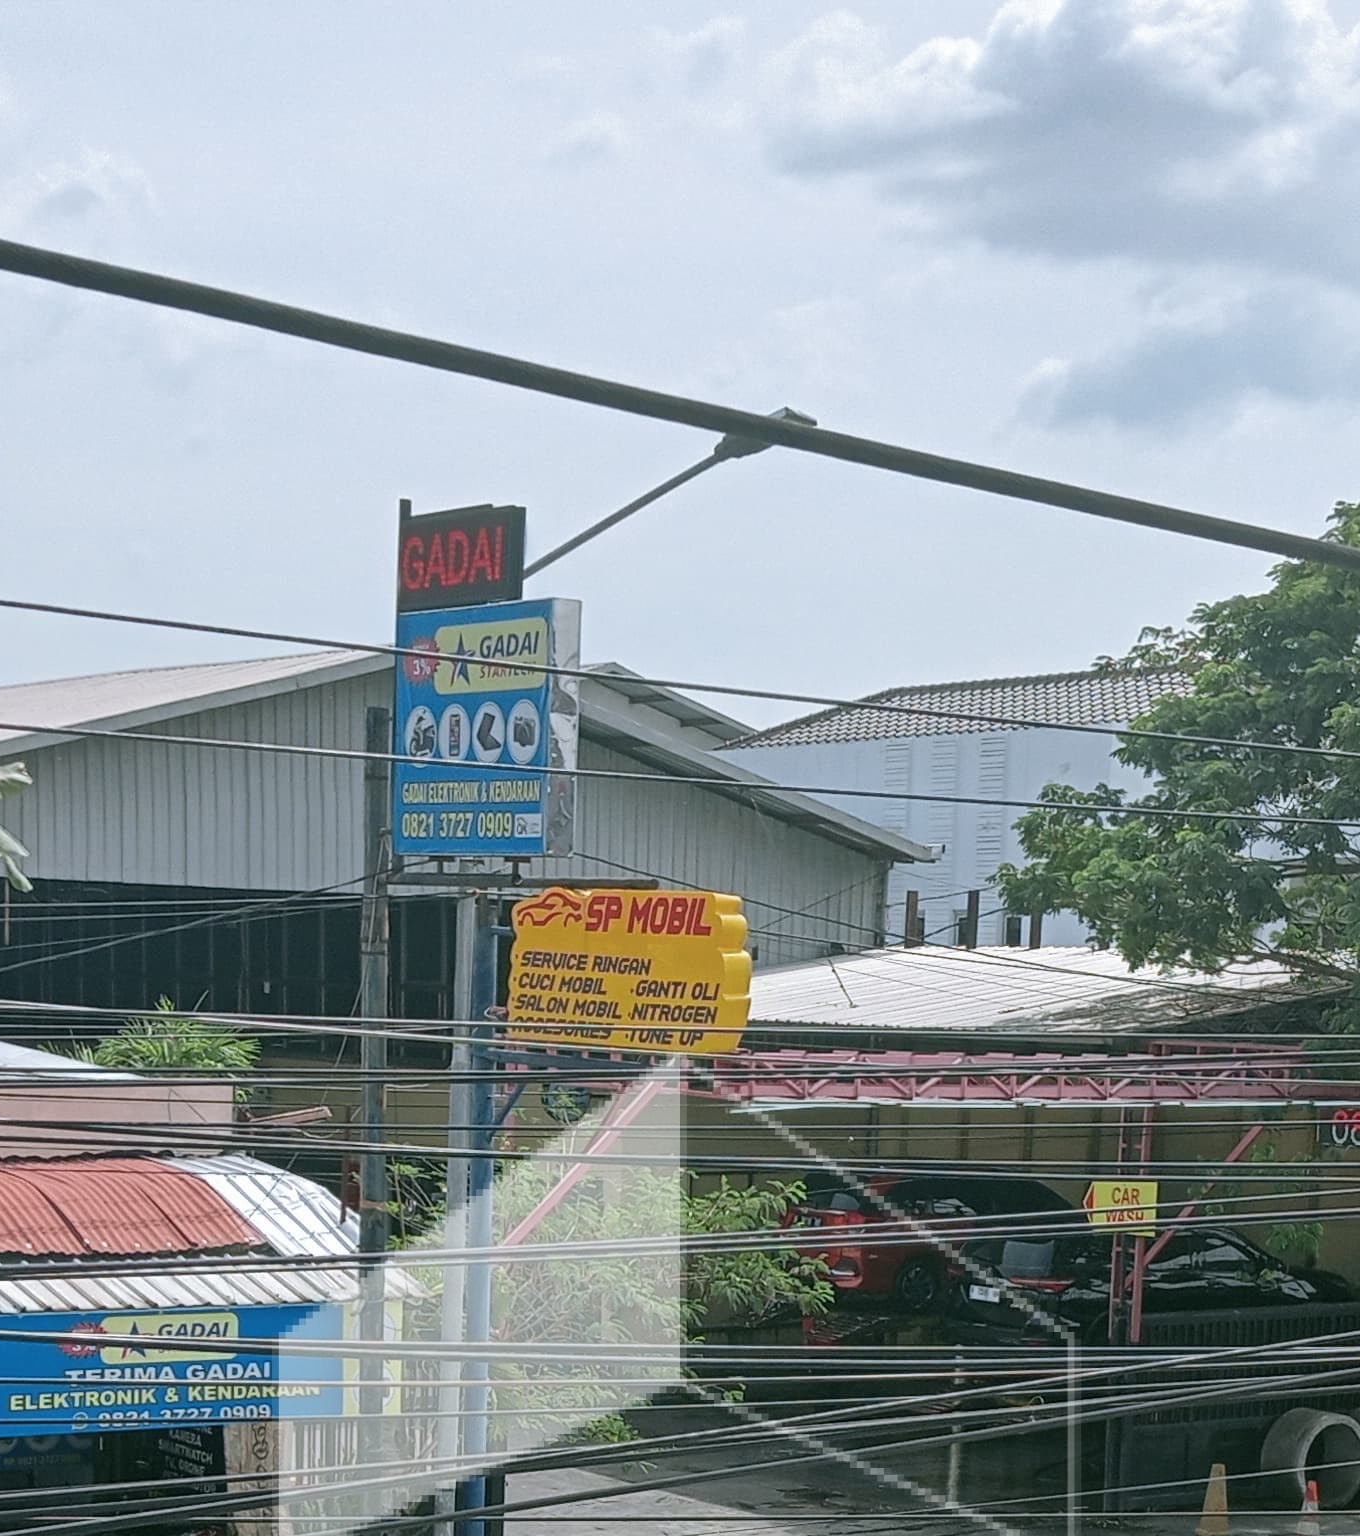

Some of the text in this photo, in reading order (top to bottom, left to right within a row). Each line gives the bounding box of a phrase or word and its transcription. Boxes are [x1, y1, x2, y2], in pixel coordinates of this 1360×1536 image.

[403, 525, 505, 590] GADAI
[479, 630, 540, 659] GADAI
[402, 782, 428, 803] GADAI
[428, 780, 481, 803] ELEKTRONIK
[490, 778, 541, 802] KENDARAAN
[402, 812, 434, 838] 0821
[440, 812, 474, 838] 3727
[477, 812, 513, 838] 0909
[585, 895, 712, 936] SP MOBIL
[520, 950, 652, 976] SERVICE RINGAN
[518, 972, 607, 995] CUCI MOBIL
[635, 979, 720, 1001] GANTI OLI
[514, 994, 622, 1020] SALON MOBIL
[630, 1003, 719, 1024] NITROGEN
[628, 1027, 704, 1047] TUNE UP
[1111, 1187, 1140, 1205] CAR
[158, 1321, 230, 1338] GADAI
[64, 1361, 271, 1387] TERIMA GADAI
[9, 1384, 321, 1412] ELEKTRONIK & KENDARAAN
[220, 1404, 272, 1420] 0909
